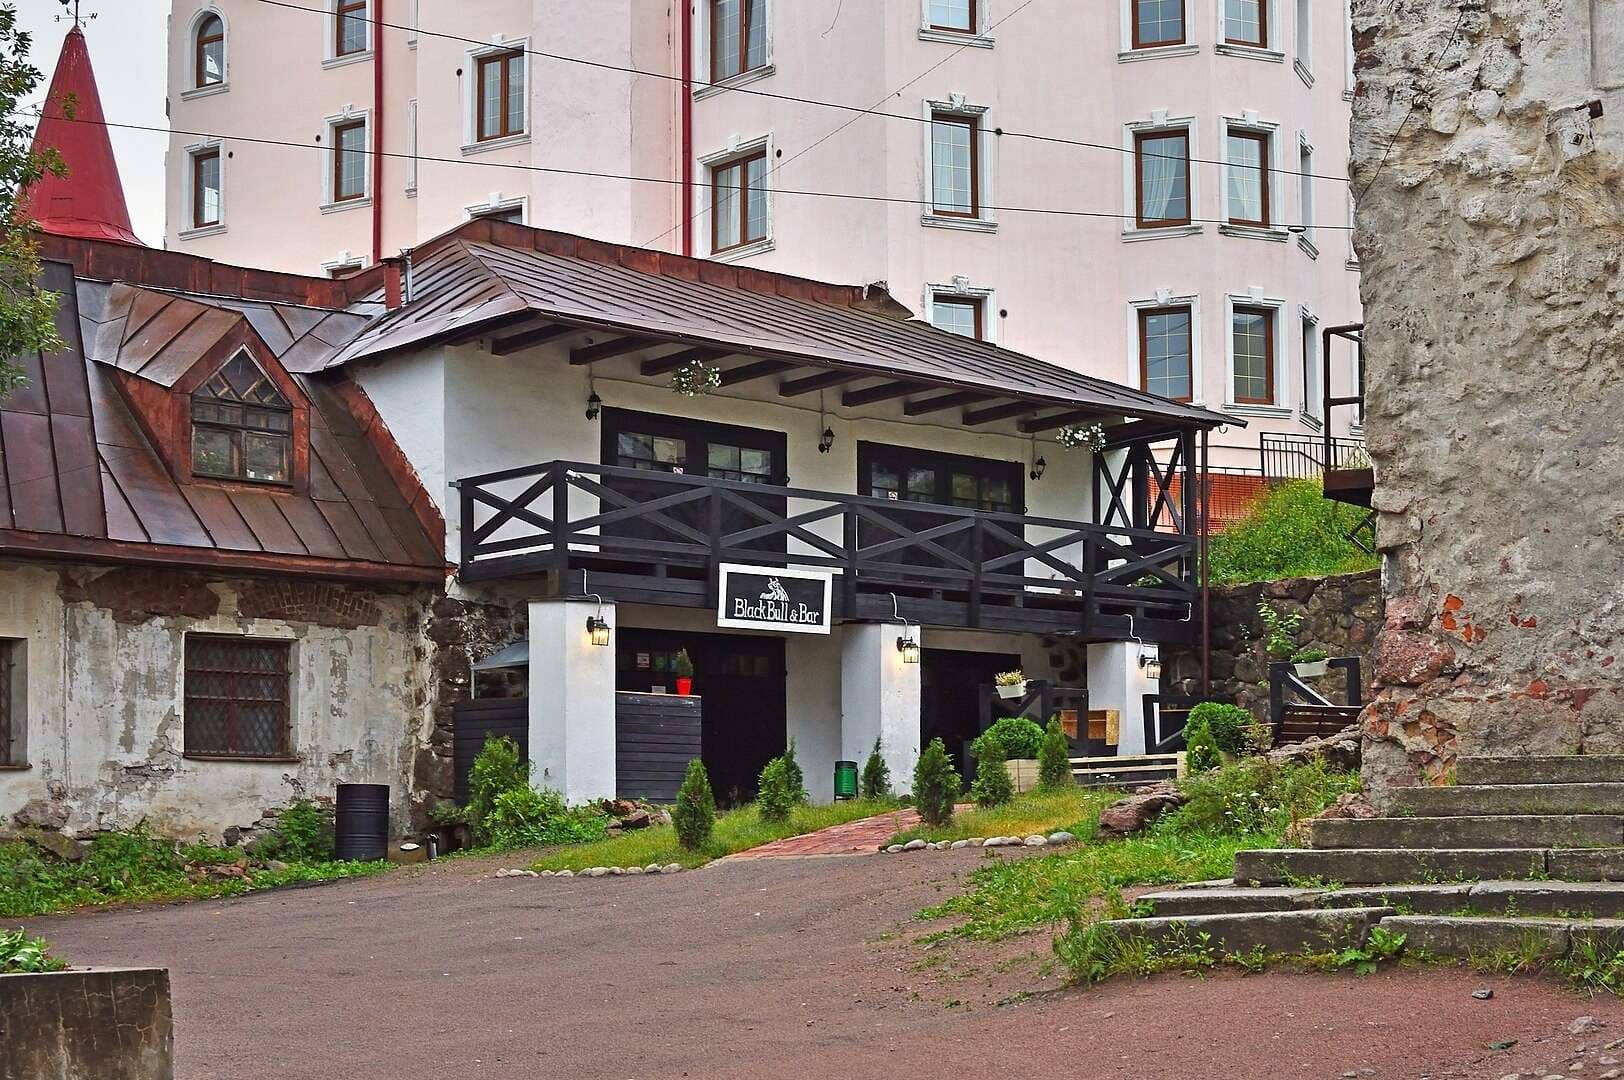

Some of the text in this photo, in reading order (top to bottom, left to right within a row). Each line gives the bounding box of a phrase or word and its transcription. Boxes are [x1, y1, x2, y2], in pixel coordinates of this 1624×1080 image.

[734, 597, 820, 624] Black Bull & Bar
